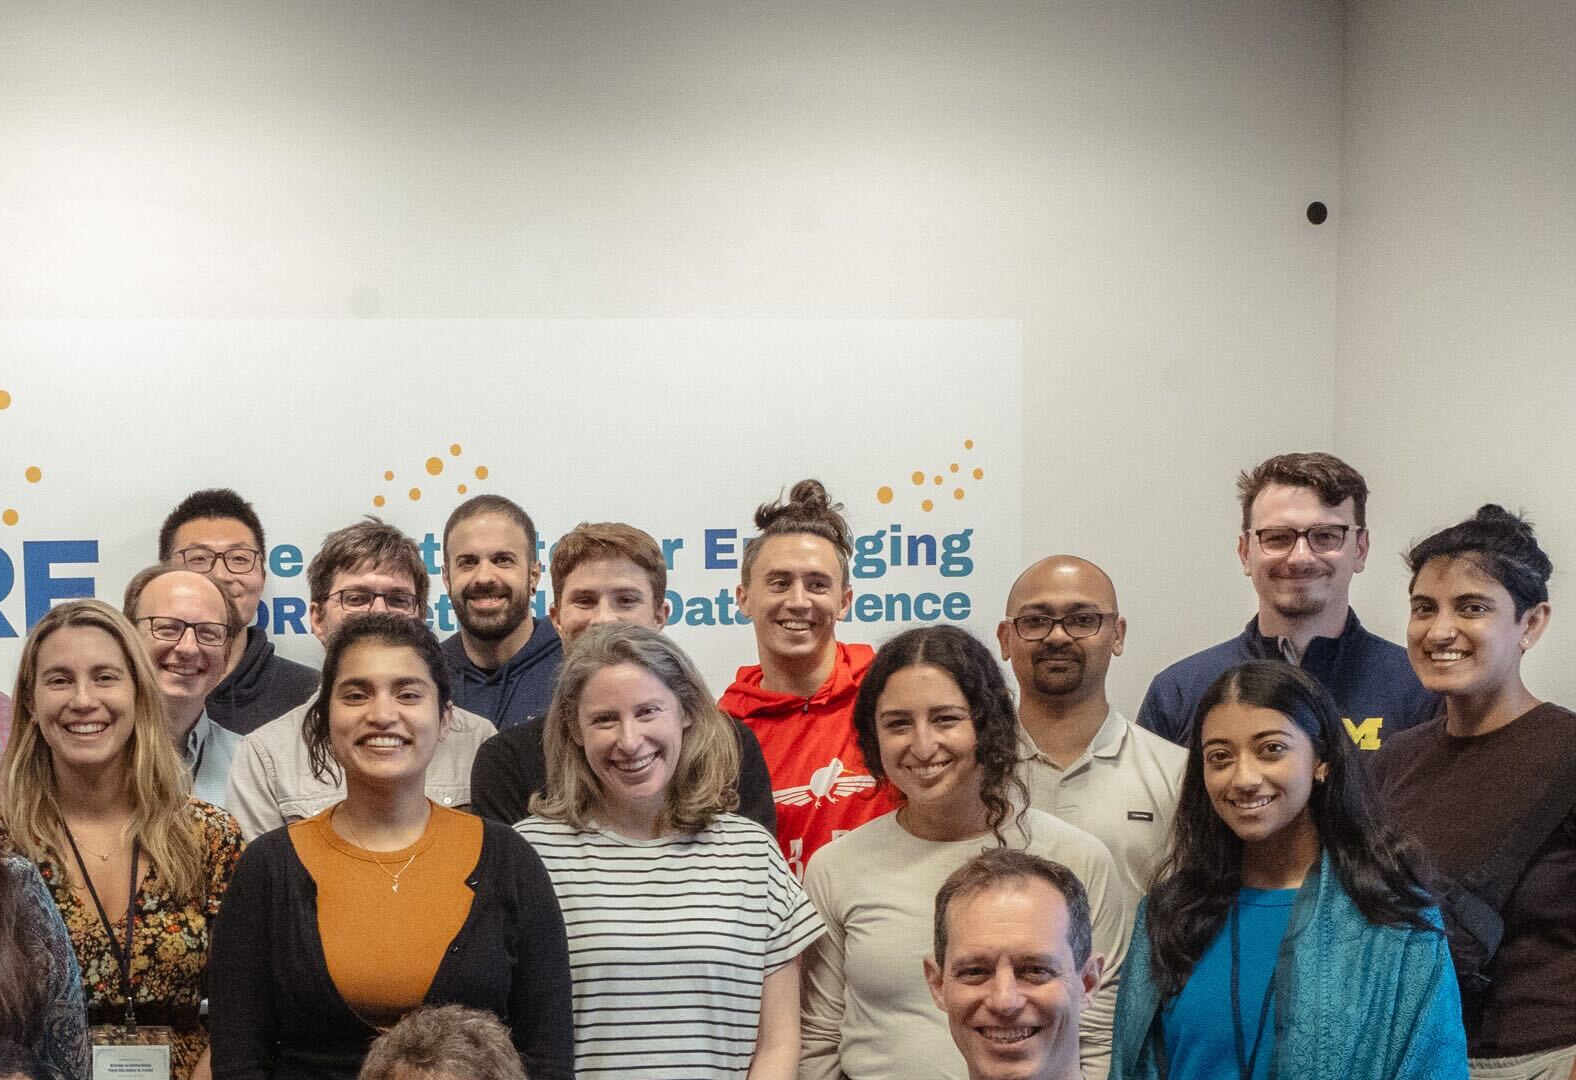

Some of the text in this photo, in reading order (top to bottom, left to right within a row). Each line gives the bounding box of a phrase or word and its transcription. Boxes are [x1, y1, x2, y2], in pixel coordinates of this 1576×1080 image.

[704, 524, 974, 578] Eging
[844, 591, 971, 623] ence
[1341, 717, 1384, 750] M
